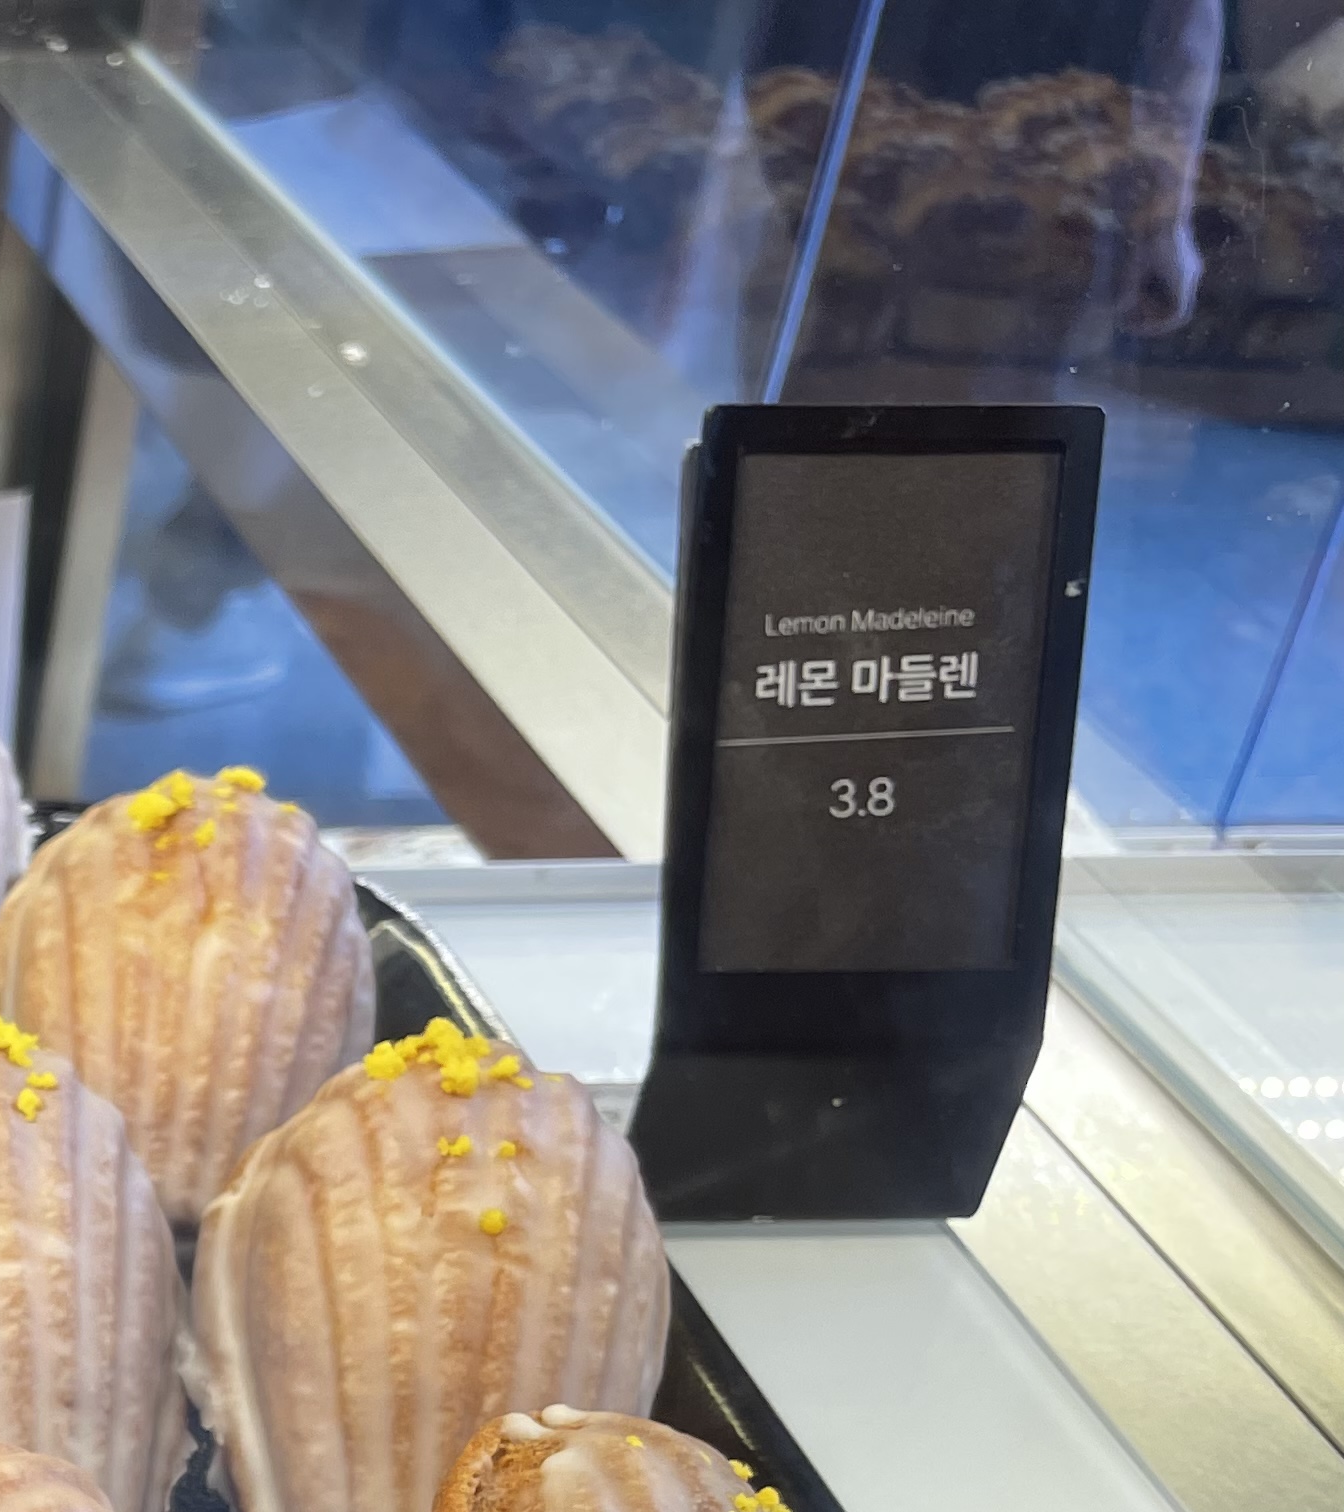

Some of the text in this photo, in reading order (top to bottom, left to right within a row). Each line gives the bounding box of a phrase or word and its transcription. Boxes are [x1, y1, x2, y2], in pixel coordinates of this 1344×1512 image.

[765, 606, 975, 636] Lemon Madeleine
[755, 651, 979, 708] 레몬 마들렌
[828, 776, 896, 819] 3.8
